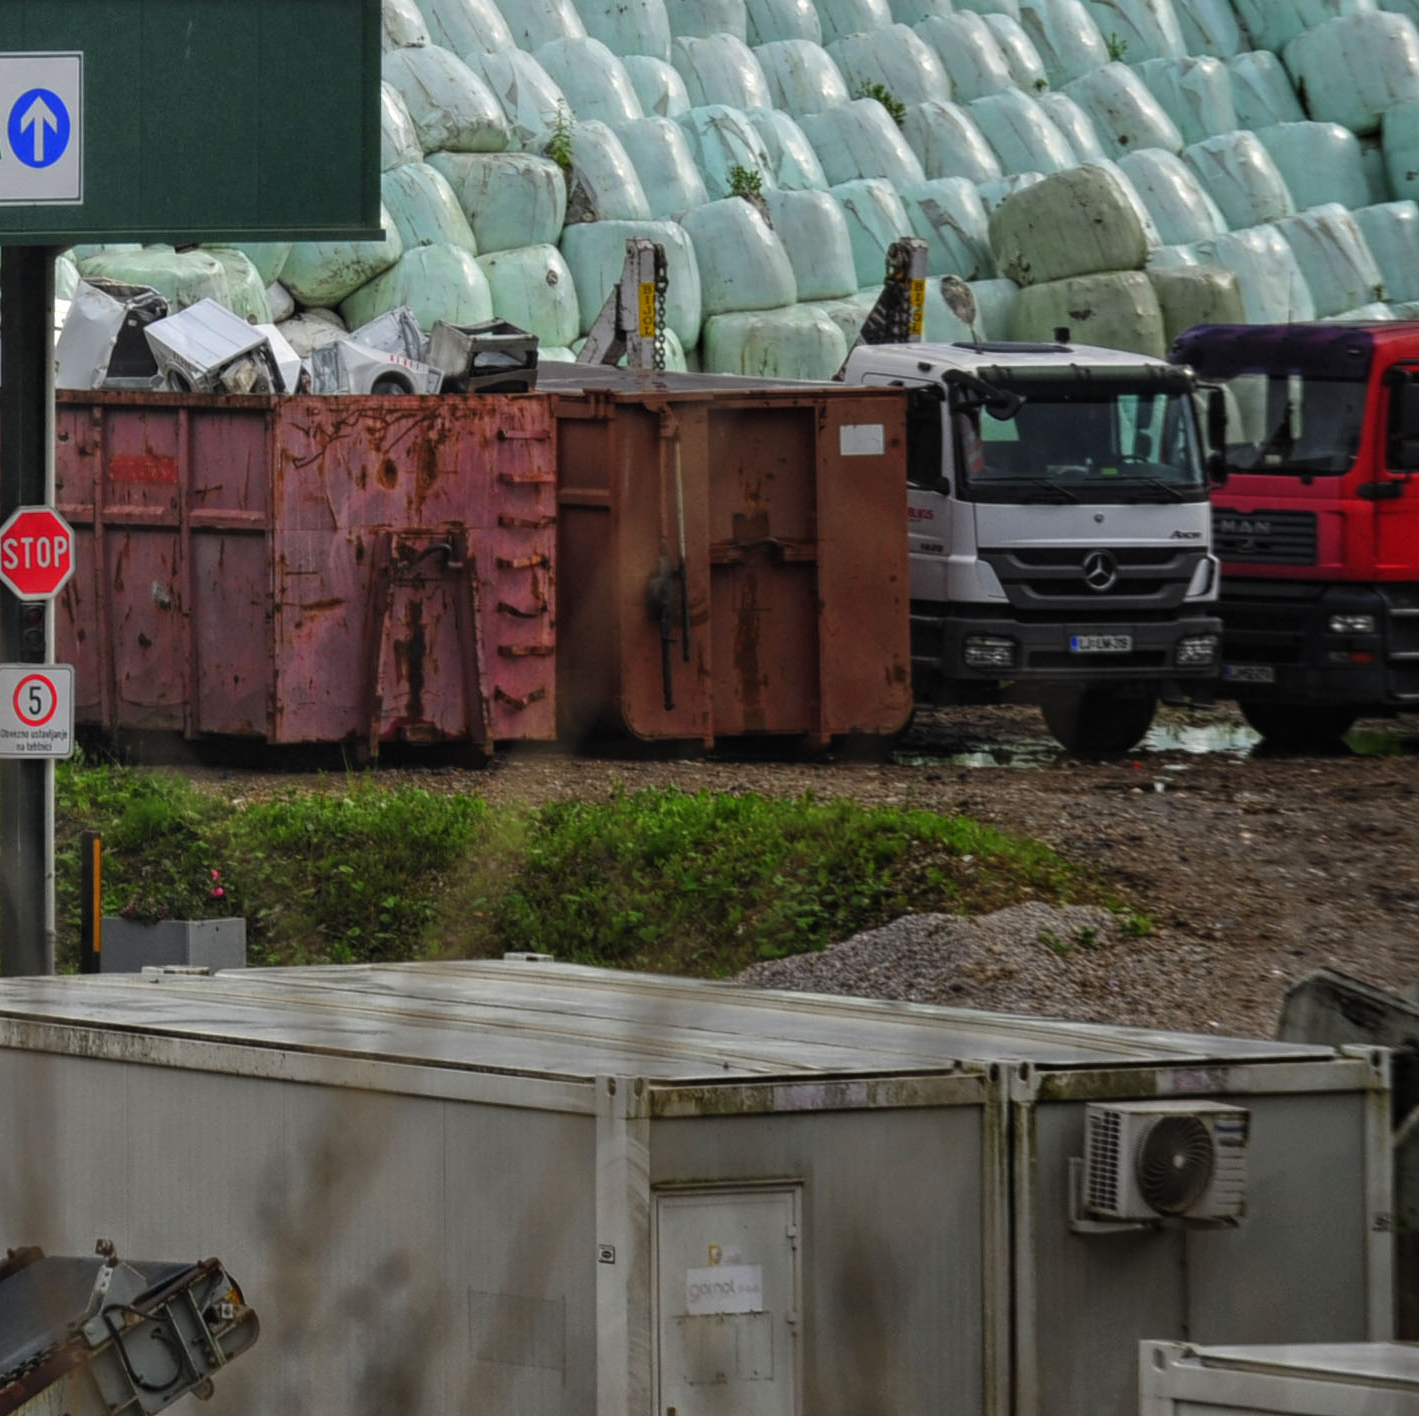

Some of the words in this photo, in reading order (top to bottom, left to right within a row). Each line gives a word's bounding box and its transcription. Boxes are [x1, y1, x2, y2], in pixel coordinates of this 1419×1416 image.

[1221, 520, 1271, 534] MAN
[3, 535, 68, 569] STOP
[29, 686, 42, 715] 5
[0, 729, 29, 738] Obvezno
[31, 729, 68, 741] ustavljanje
[27, 742, 52, 751] tehtnici
